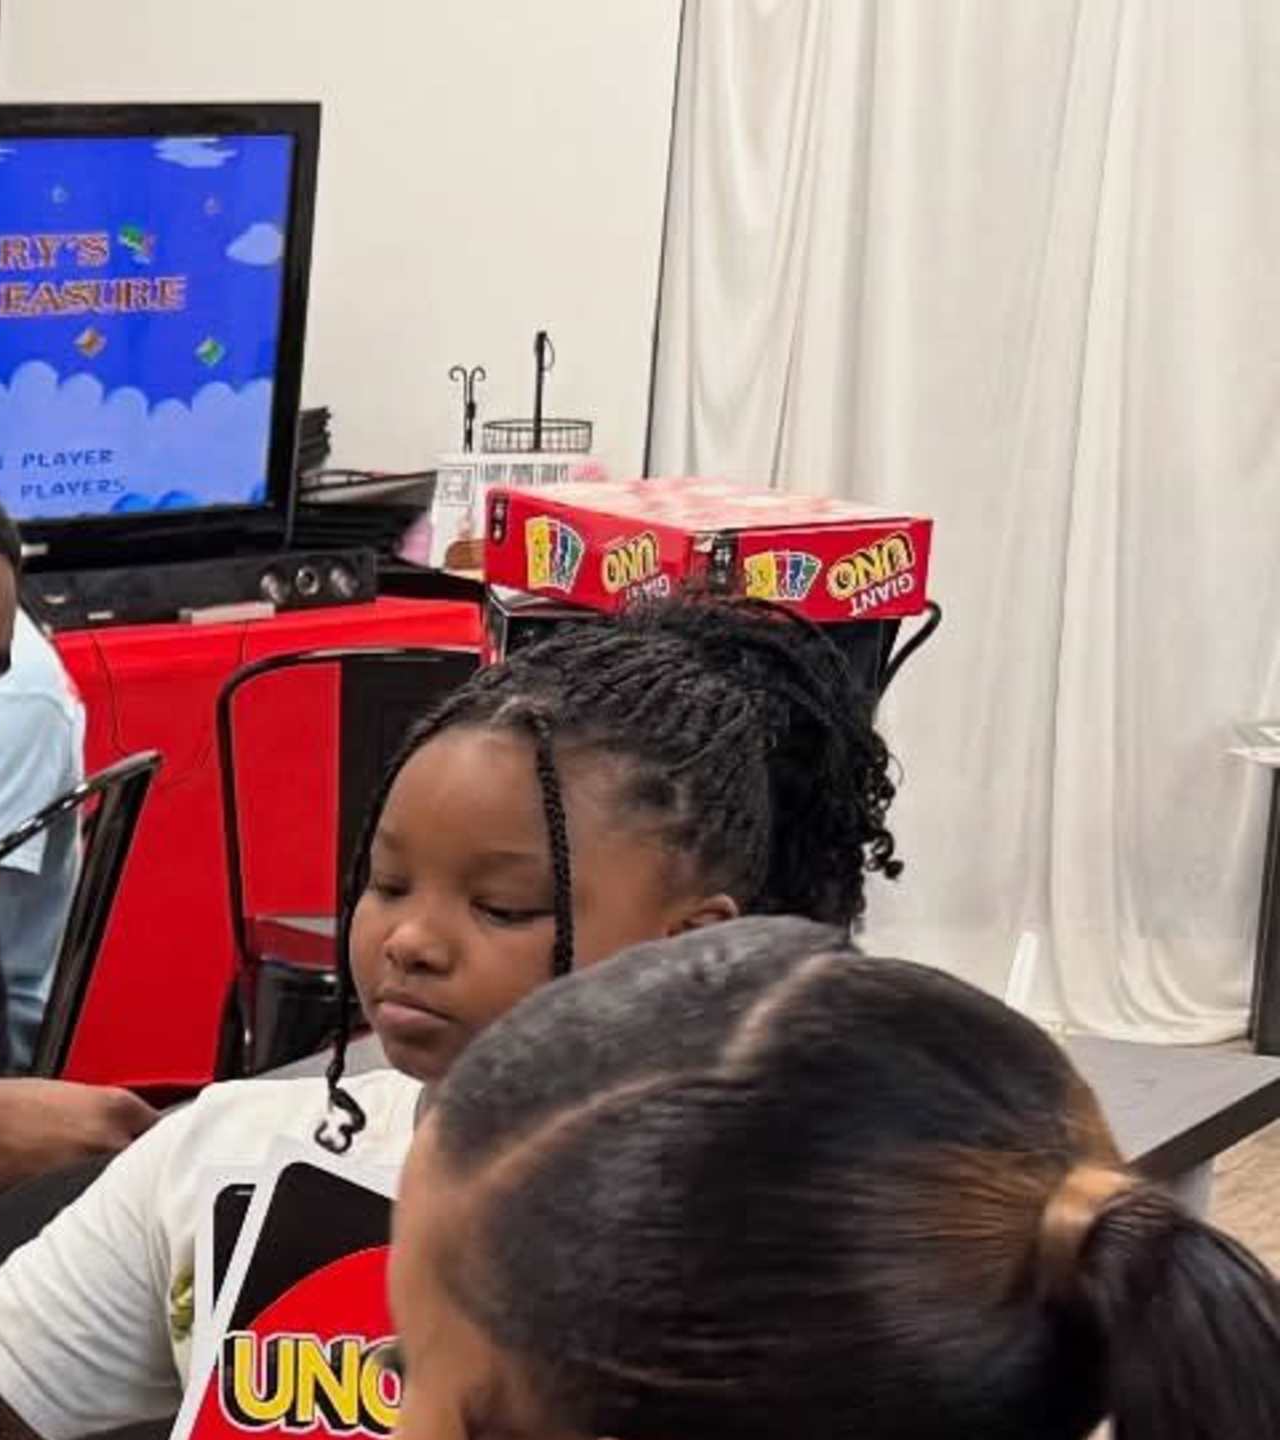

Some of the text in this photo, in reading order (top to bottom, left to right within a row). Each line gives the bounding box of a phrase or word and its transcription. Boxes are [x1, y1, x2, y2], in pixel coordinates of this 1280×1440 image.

[21, 449, 113, 468] PLAYER
[20, 478, 127, 499] PLAYERS
[602, 530, 660, 593] UNO
[826, 530, 915, 600] UNO
[849, 573, 915, 617] GIANT
